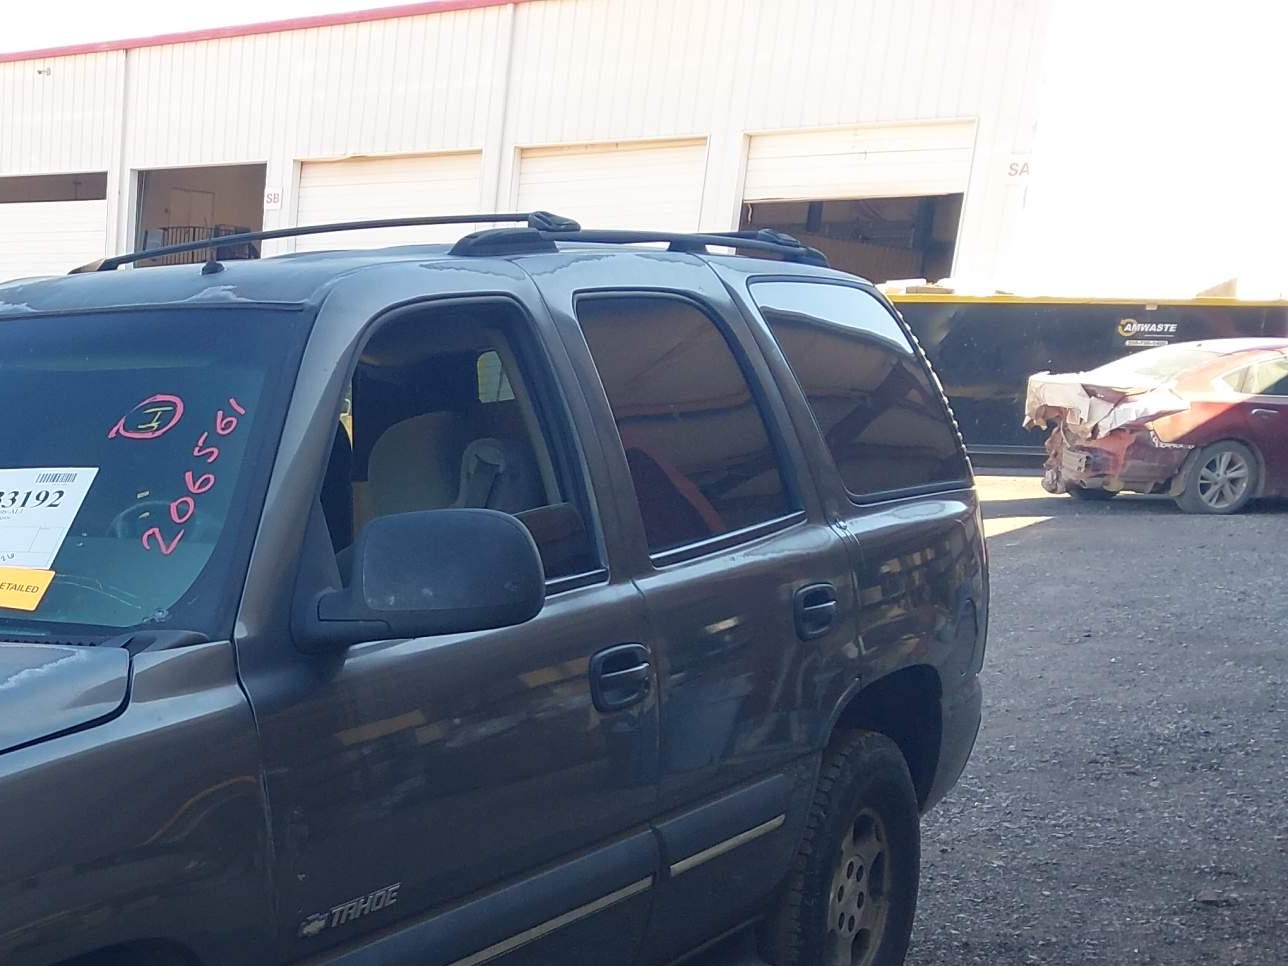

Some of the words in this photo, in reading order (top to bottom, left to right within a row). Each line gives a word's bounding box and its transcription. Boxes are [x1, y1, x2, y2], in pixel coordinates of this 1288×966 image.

[266, 192, 280, 204] SB
[1123, 323, 1178, 333] AMWASTE
[330, 882, 401, 928] TAHOE
